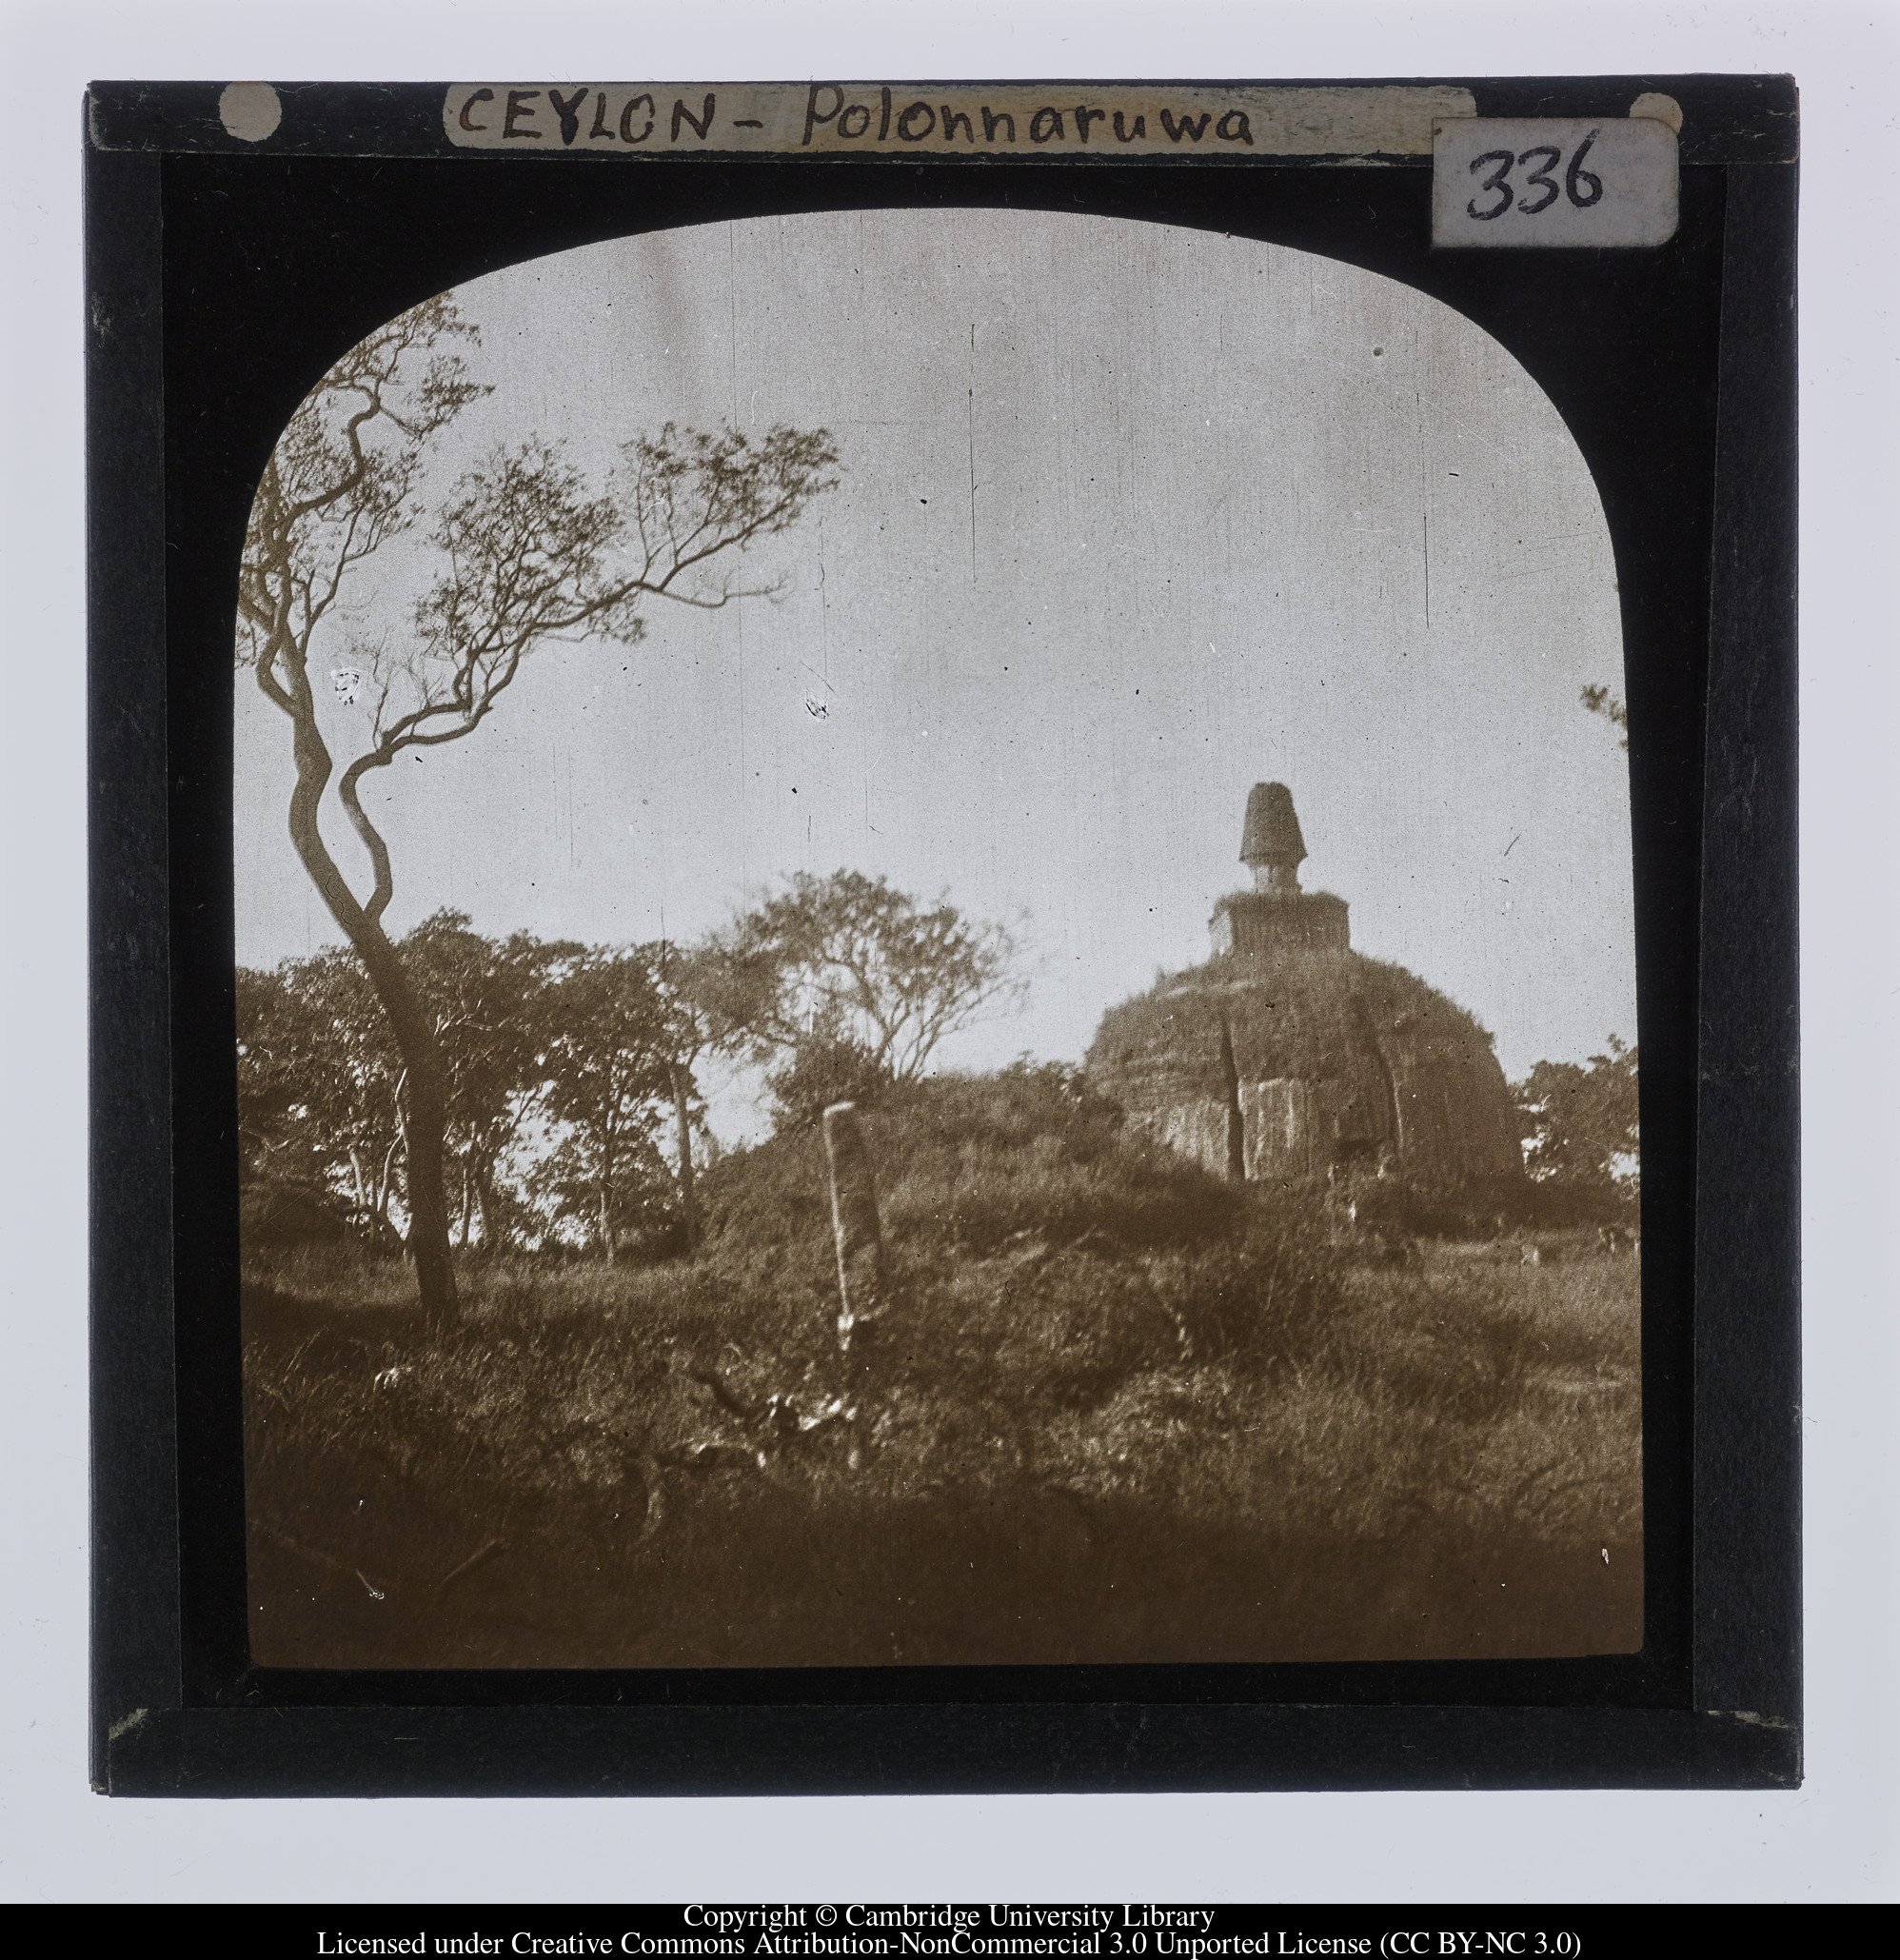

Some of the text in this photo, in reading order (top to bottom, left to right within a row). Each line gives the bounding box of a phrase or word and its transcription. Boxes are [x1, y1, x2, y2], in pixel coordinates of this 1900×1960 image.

[459, 87, 716, 146] CEYLON
[802, 83, 1255, 147] Polonnaruwa
[1466, 128, 1604, 221] 336
